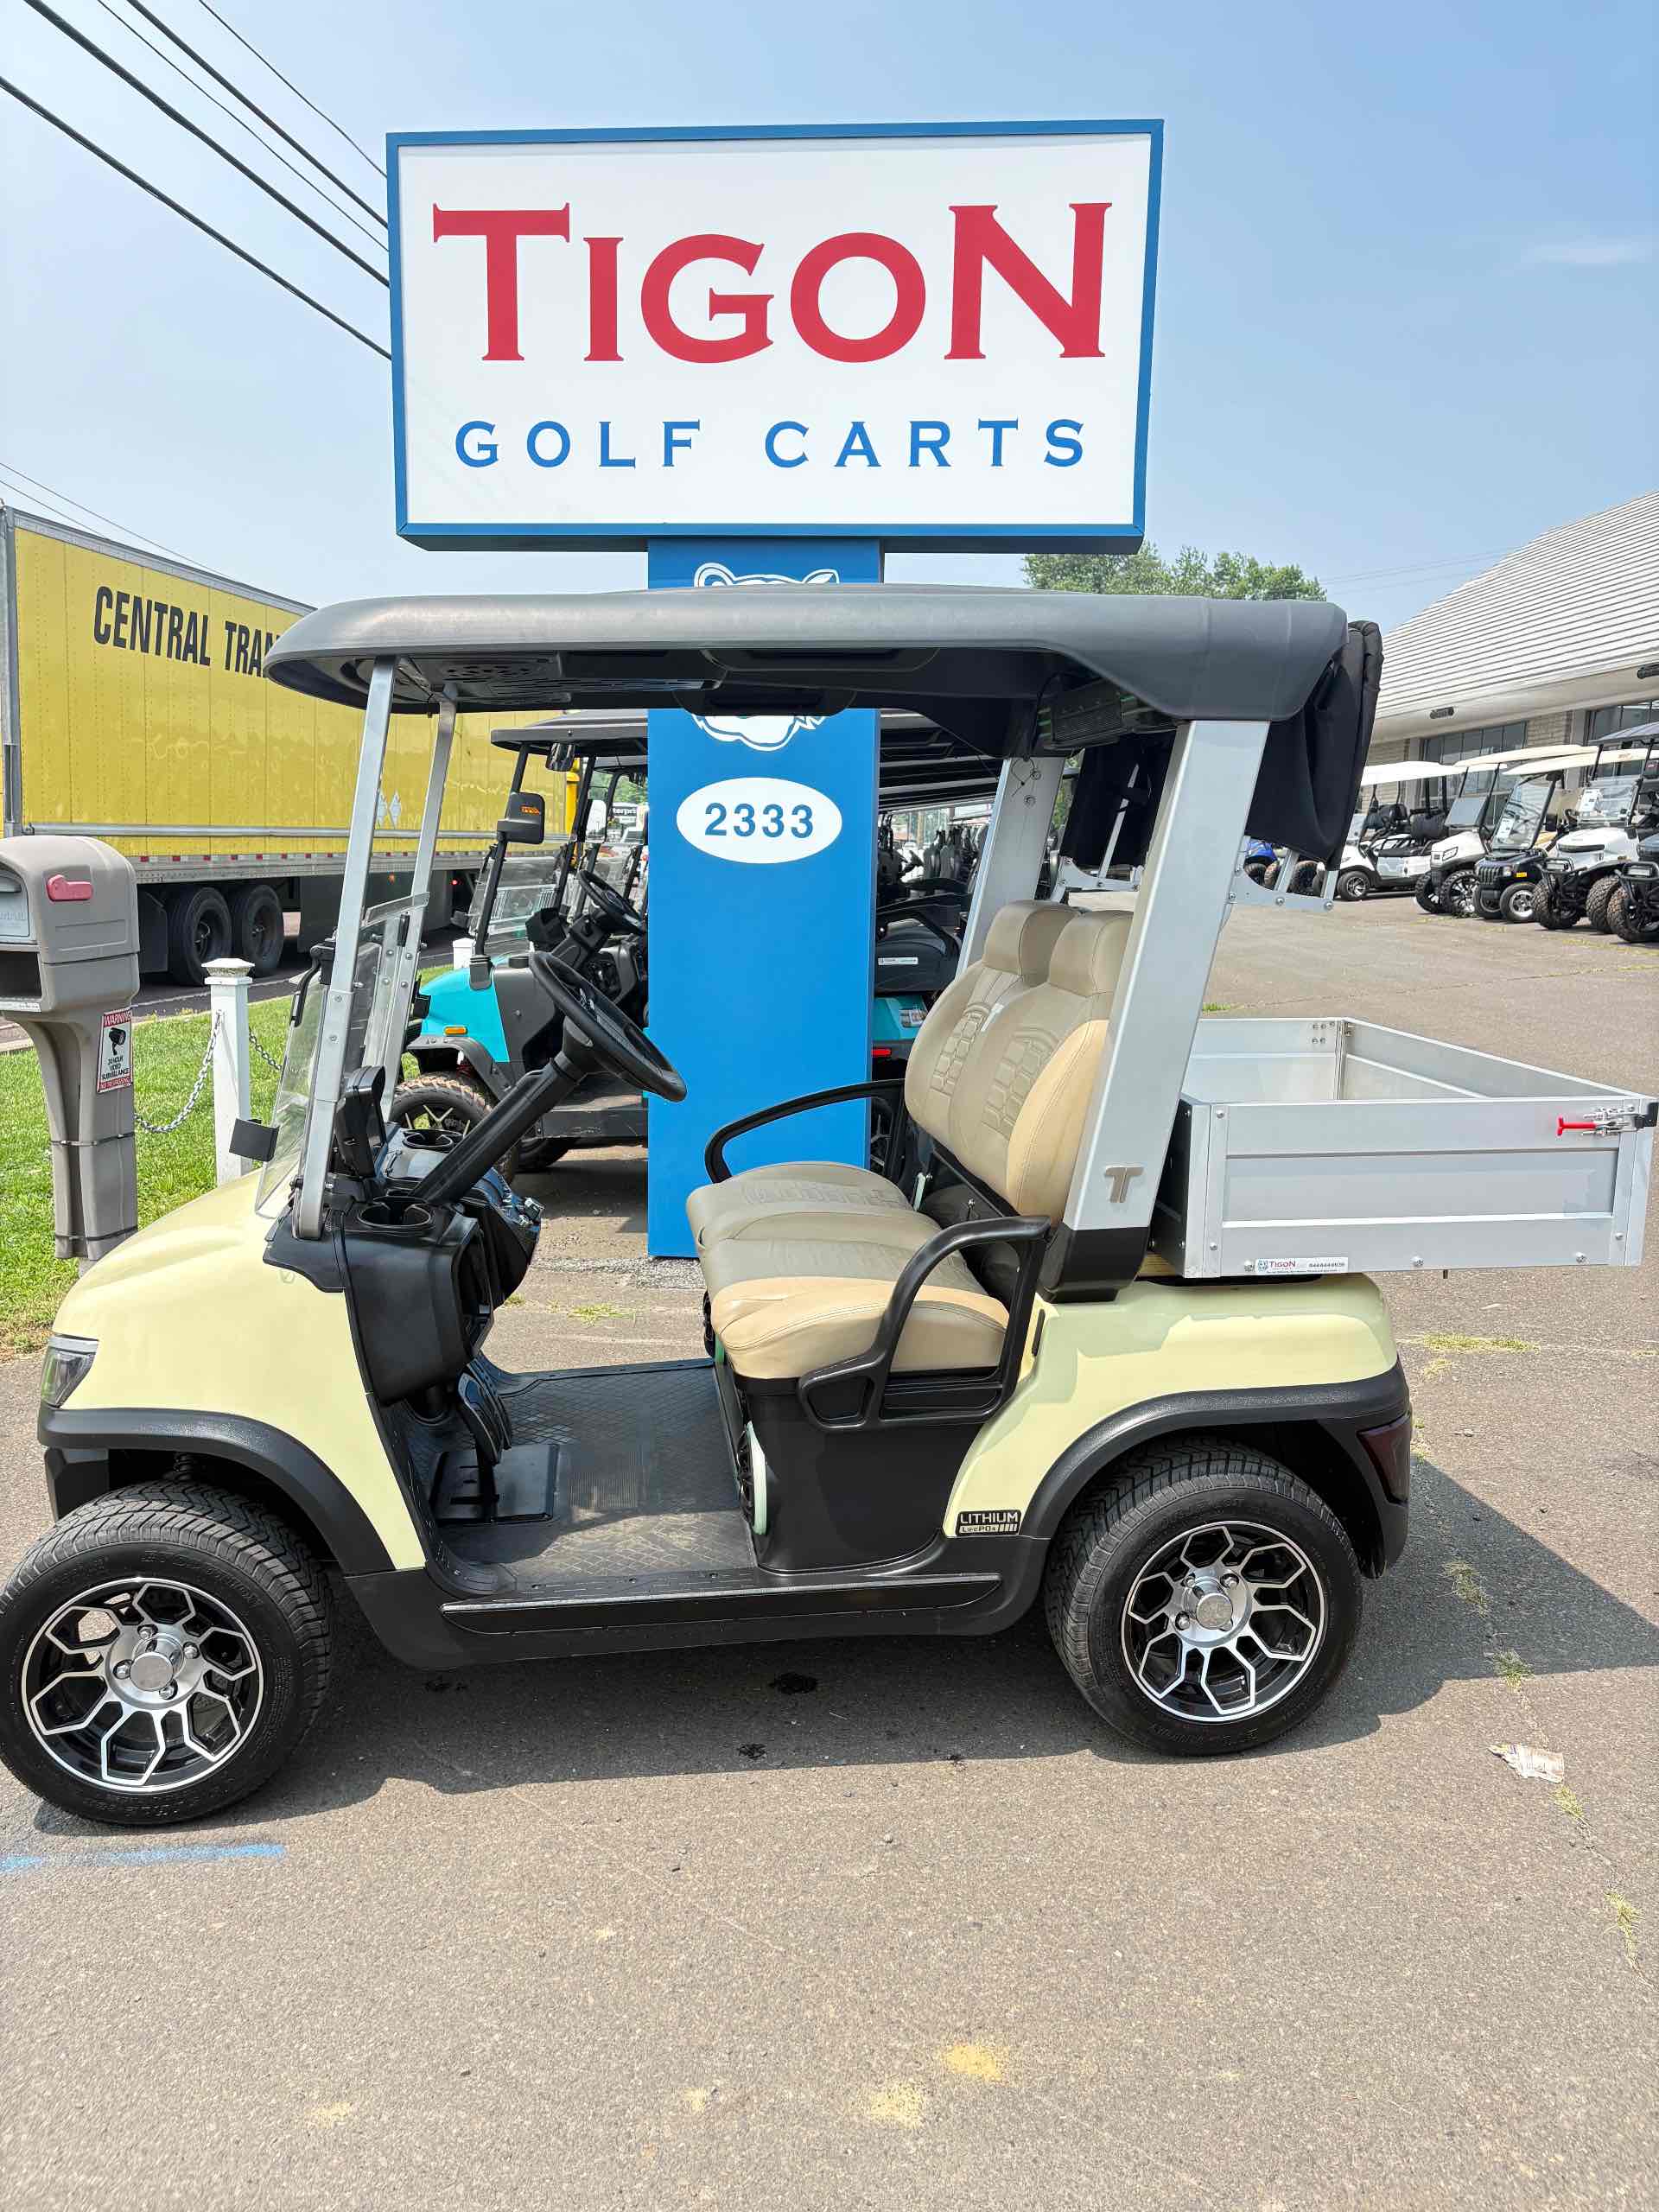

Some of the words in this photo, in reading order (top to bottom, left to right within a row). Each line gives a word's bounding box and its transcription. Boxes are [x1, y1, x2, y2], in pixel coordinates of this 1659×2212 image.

[433, 201, 1113, 364] TIGON
[455, 420, 701, 469] GOLF
[765, 419, 1084, 468] CARTS
[93, 586, 211, 666] CENTRAL
[704, 803, 815, 839] 2333
[104, 1010, 131, 1027] WARNING
[960, 1512, 1019, 1524] LITHIUM
